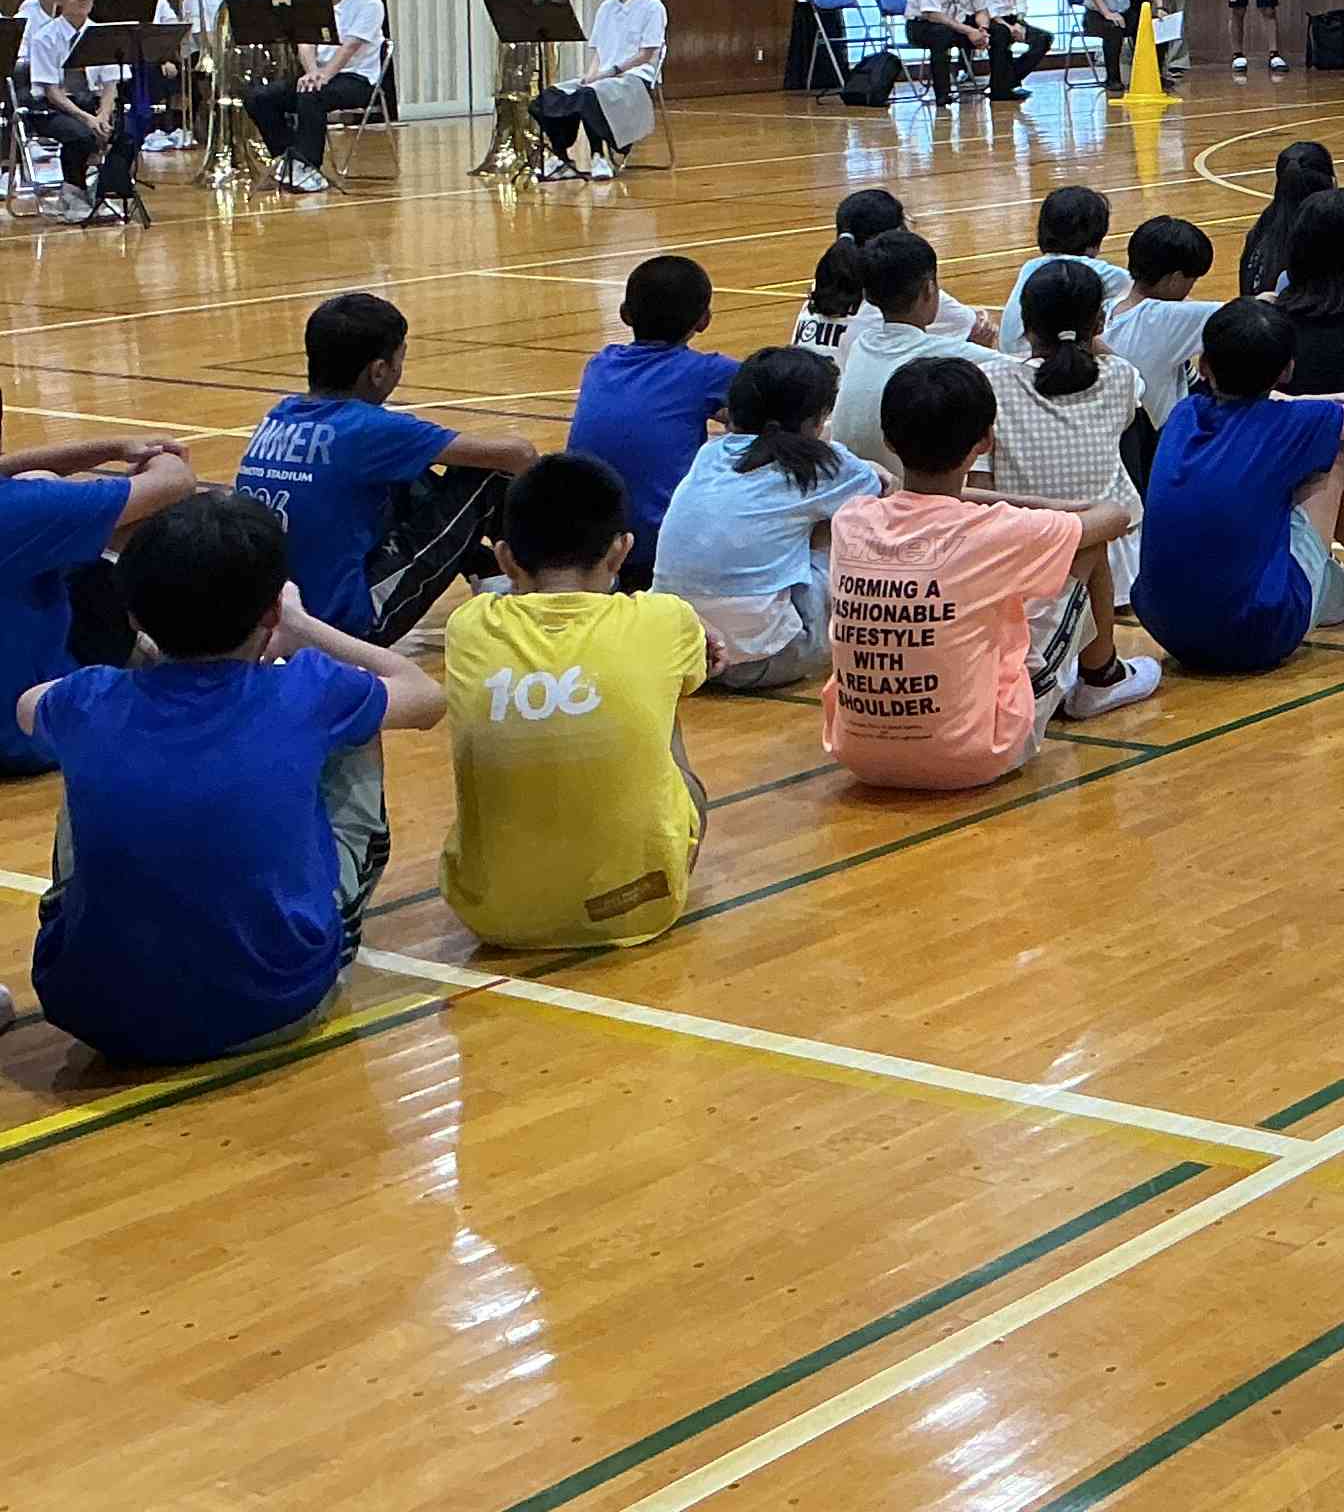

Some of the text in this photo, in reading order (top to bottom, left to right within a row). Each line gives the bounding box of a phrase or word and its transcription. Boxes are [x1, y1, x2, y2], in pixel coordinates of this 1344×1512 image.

[265, 469, 313, 483] STADIUM
[838, 574, 941, 599] FORMING A
[834, 623, 935, 648] LIFESTYLE
[853, 650, 904, 671] WITH
[484, 664, 602, 721] 106
[845, 672, 939, 695] RELAXED
[838, 689, 941, 717] SHOULDER.
